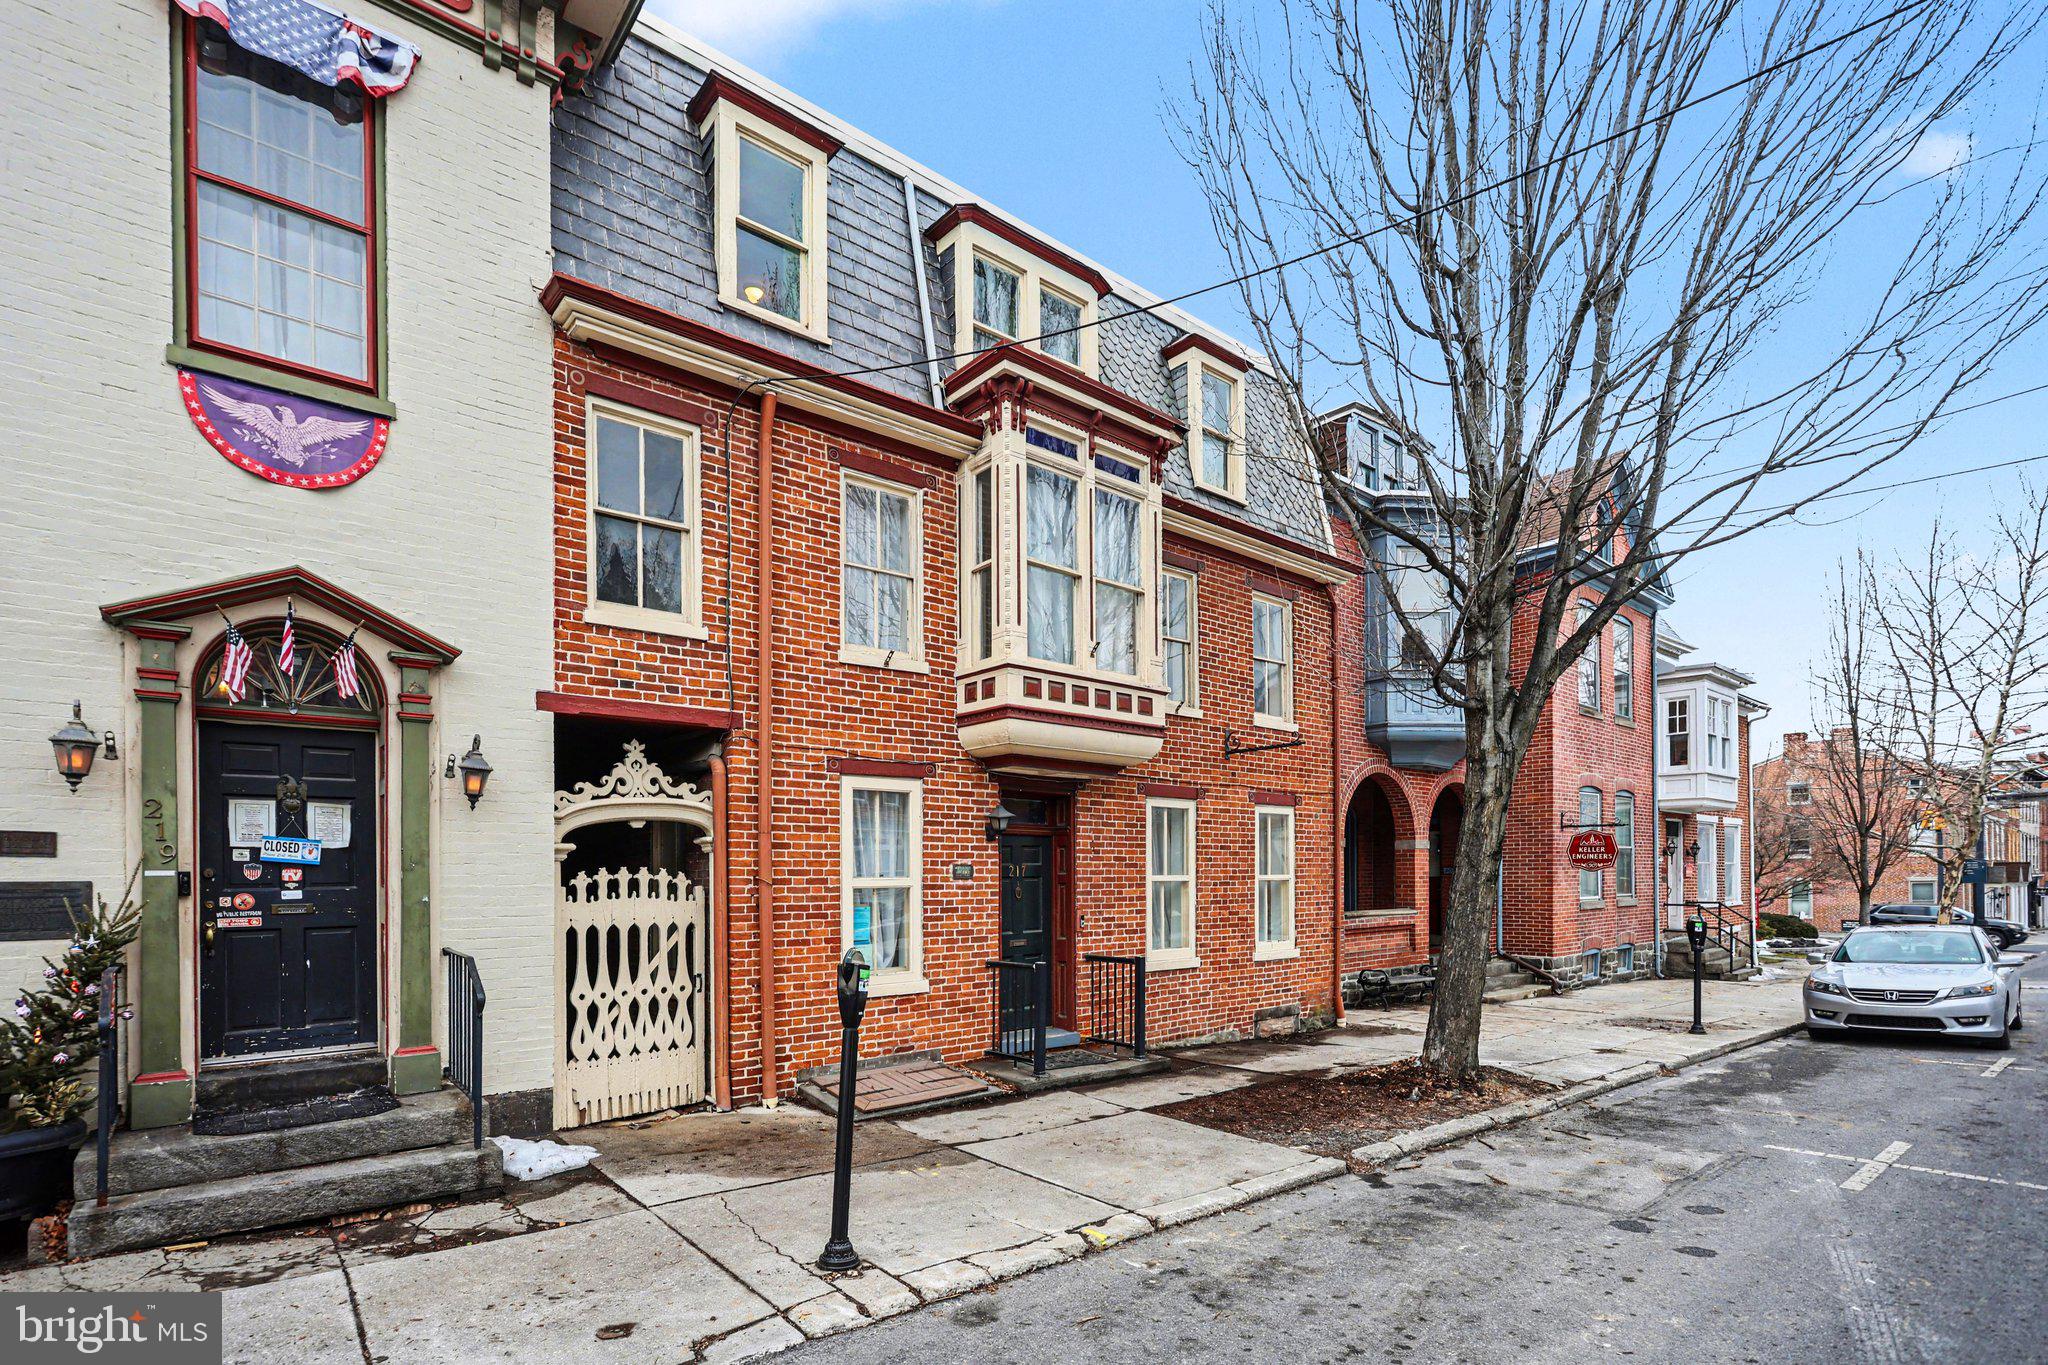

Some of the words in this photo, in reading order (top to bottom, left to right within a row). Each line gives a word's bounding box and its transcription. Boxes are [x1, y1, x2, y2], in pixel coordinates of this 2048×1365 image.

[143, 798, 177, 865] 219
[263, 840, 300, 854] CLOSED
[1008, 865, 1025, 877] 217
